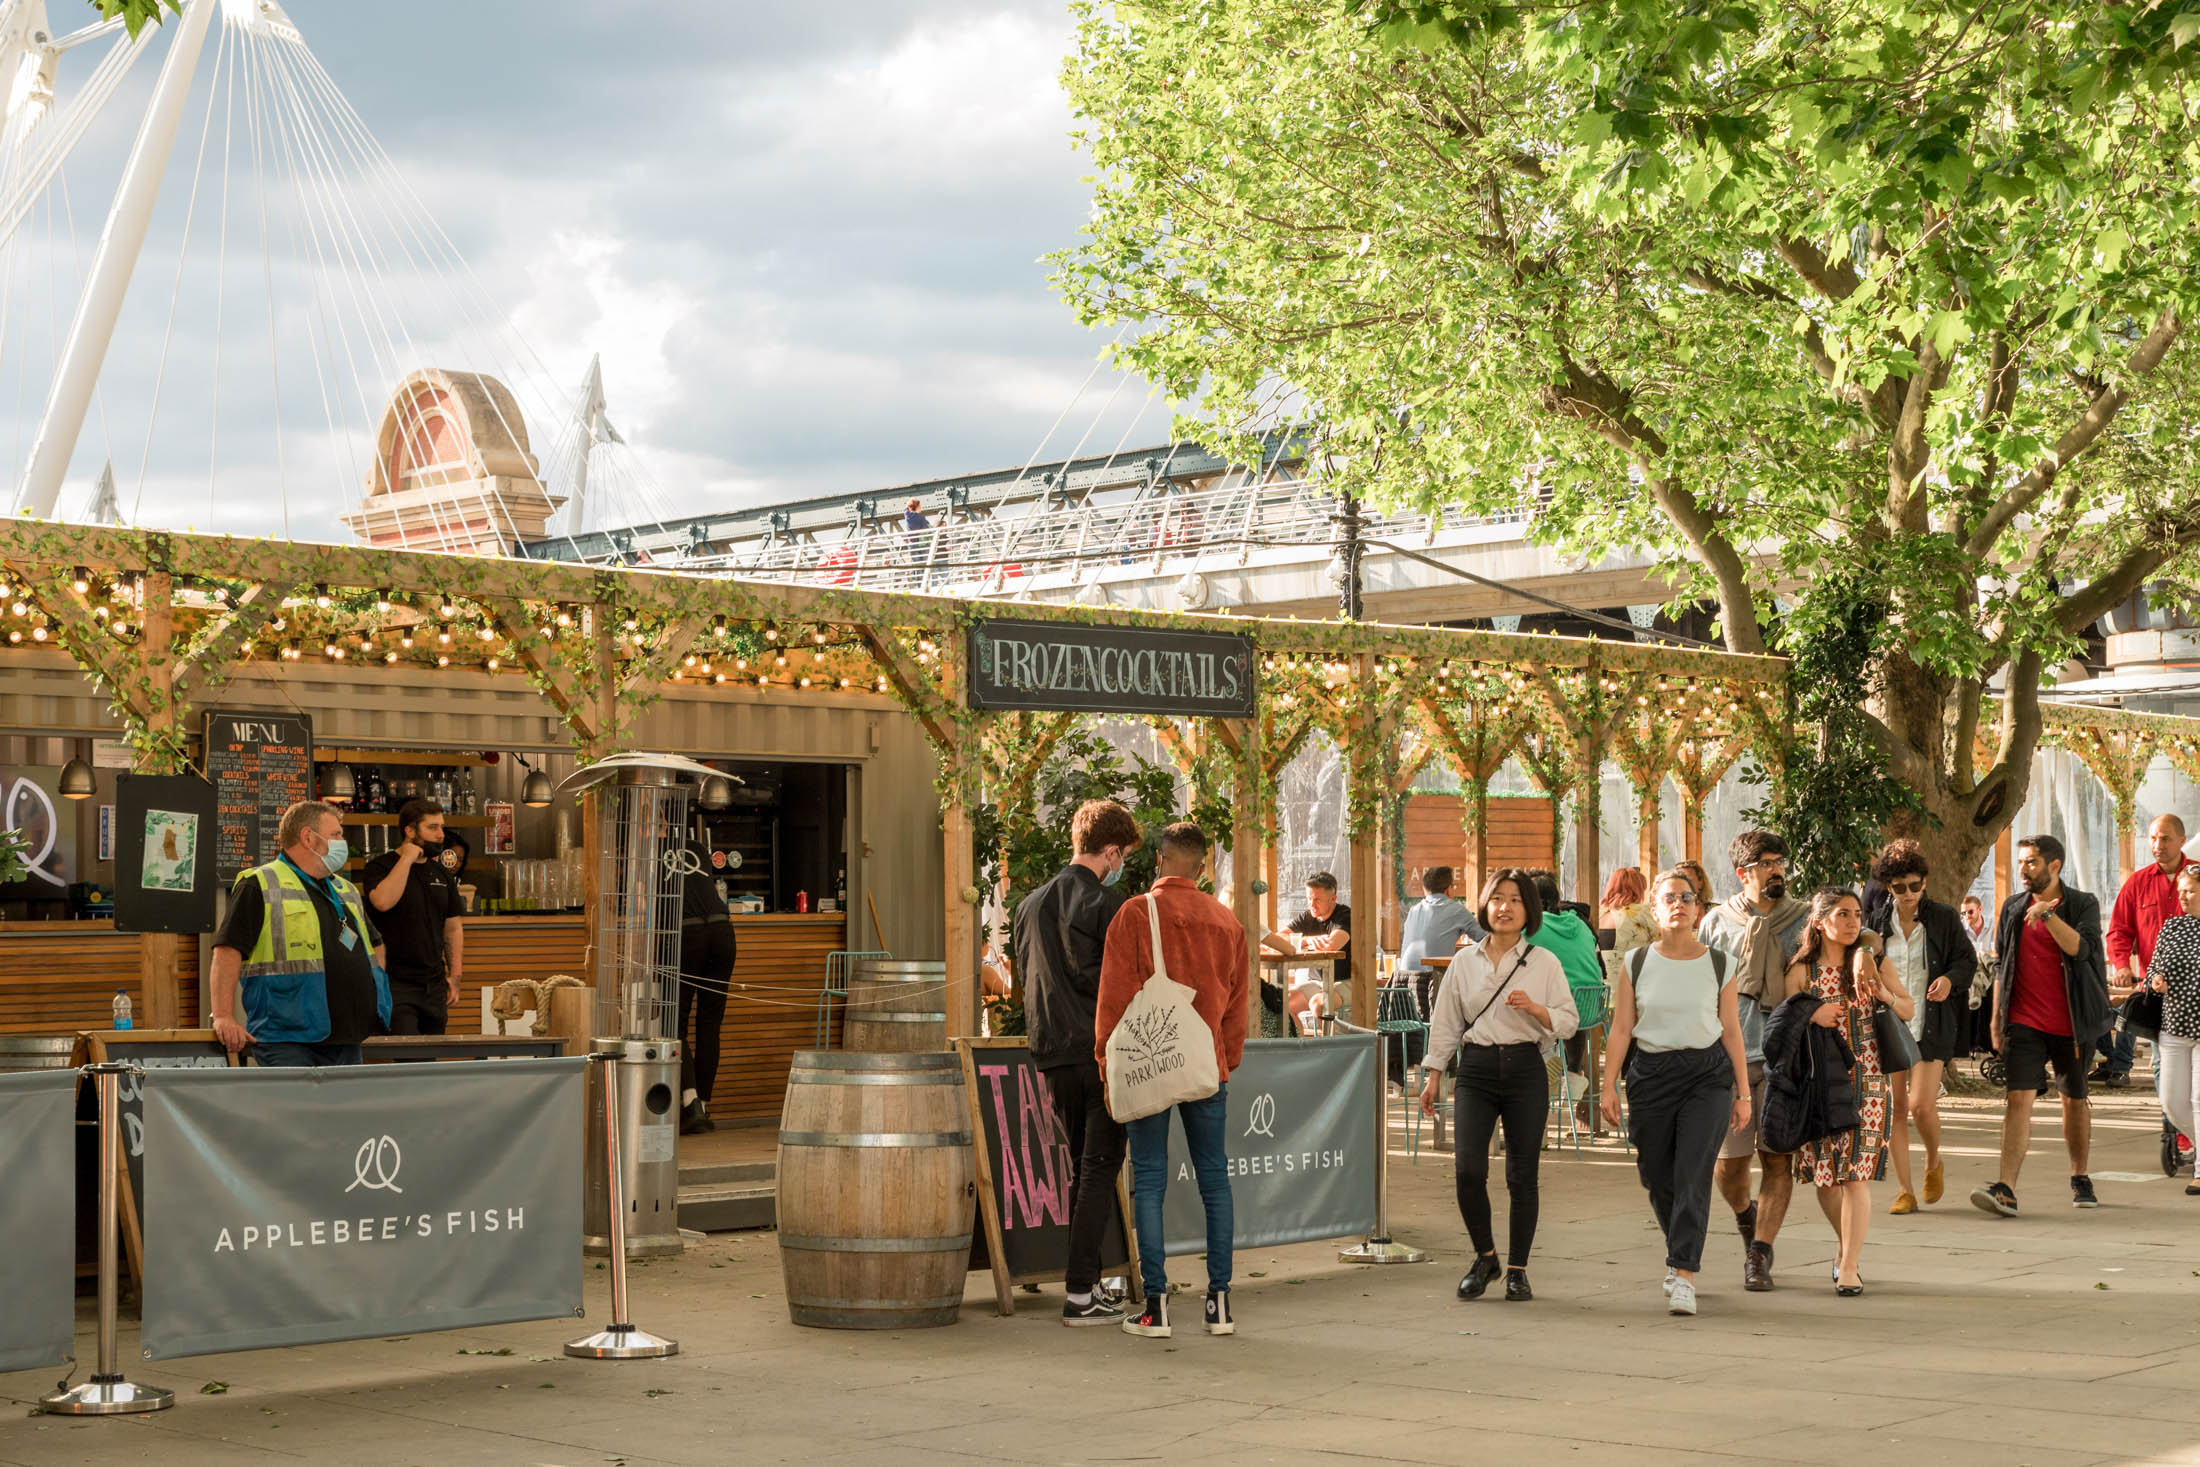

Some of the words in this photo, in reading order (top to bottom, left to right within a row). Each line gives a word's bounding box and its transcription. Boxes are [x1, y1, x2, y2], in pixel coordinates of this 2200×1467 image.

[232, 722, 285, 743] MENU
[979, 1064, 1071, 1148] TAK
[1002, 1143, 1076, 1230] AWA
[1177, 1154, 1295, 1181] AEBEE'S
[1302, 1149, 1344, 1171] FISH
[214, 1213, 432, 1252] APPLEBEE'S
[447, 1207, 525, 1235] FISH
